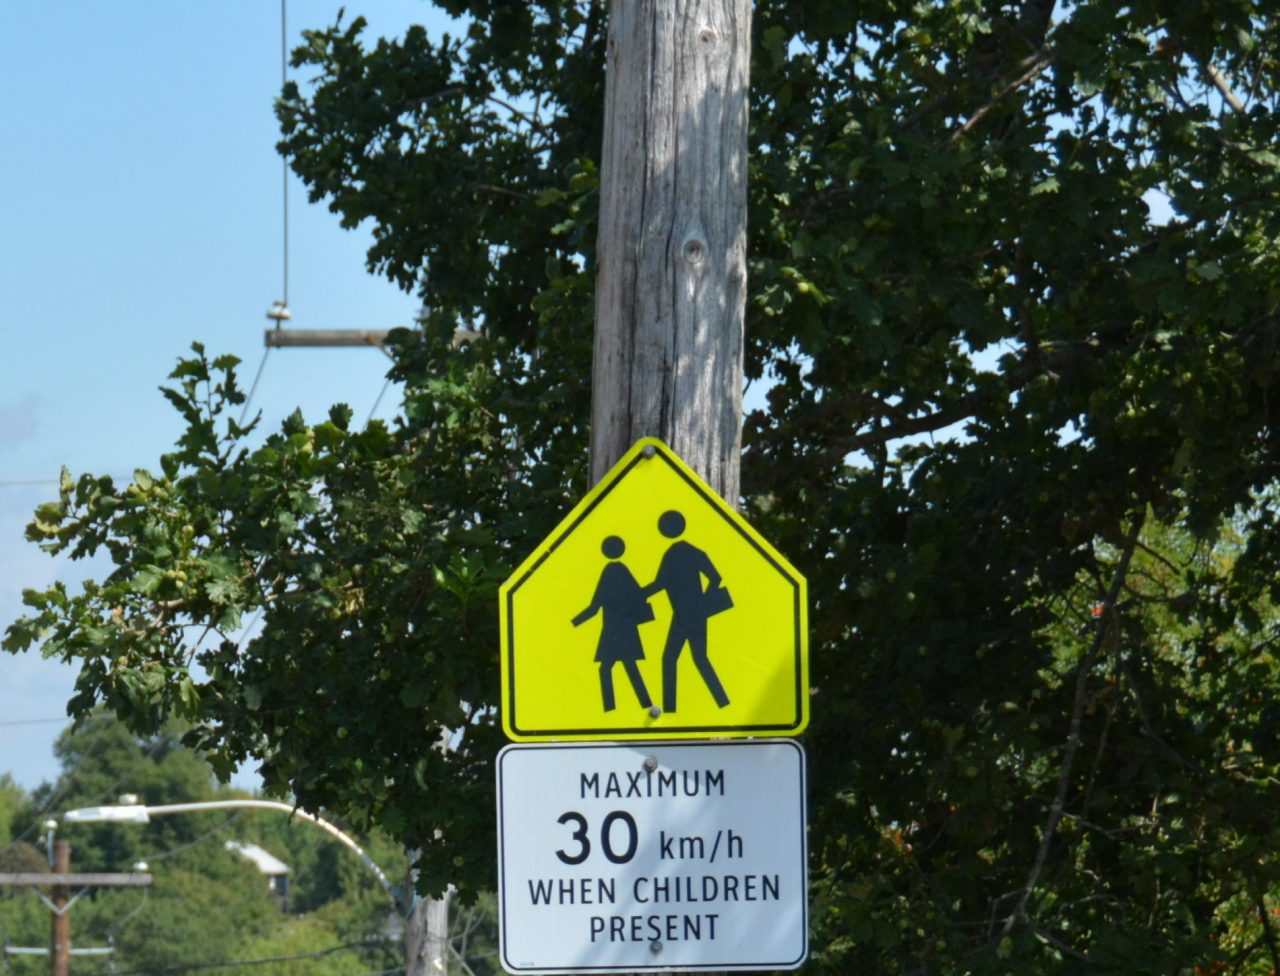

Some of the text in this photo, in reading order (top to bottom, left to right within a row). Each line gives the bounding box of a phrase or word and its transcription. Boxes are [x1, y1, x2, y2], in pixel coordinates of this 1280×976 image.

[579, 769, 725, 799] MAXIMUM
[555, 810, 744, 866] 30 km/h
[528, 874, 780, 906] WHEN CHILDREN
[590, 914, 720, 943] PRESENT
